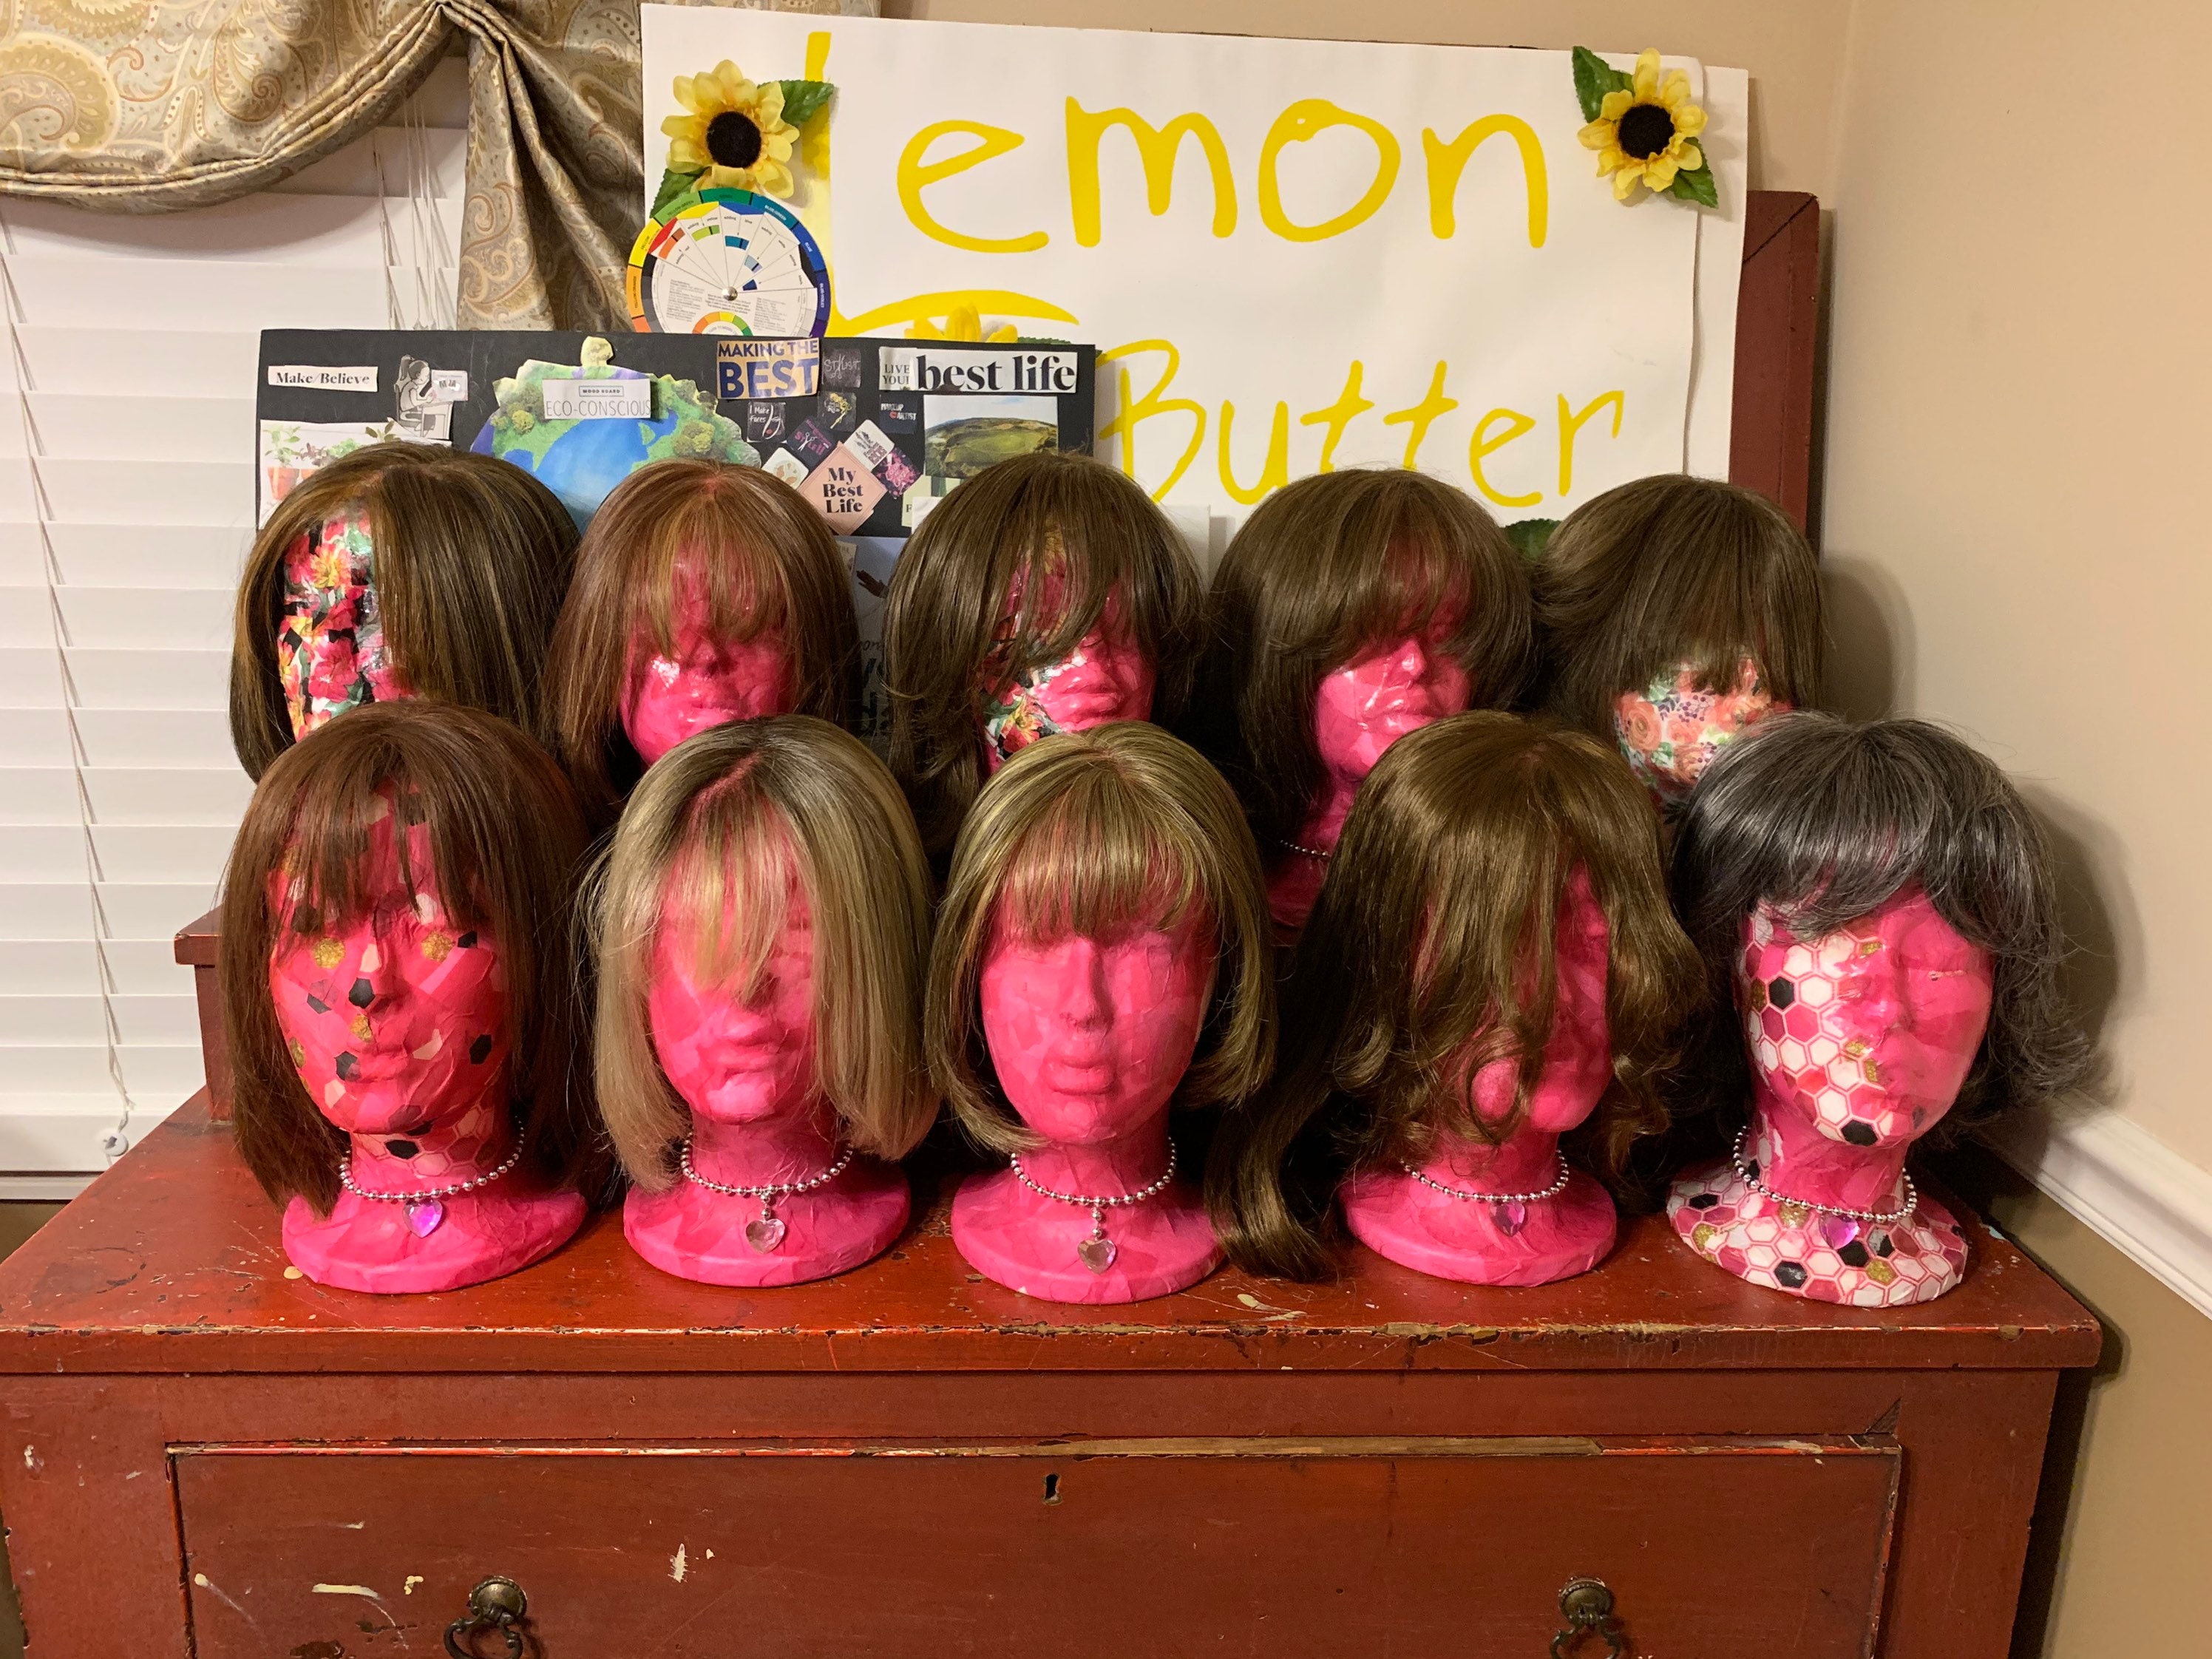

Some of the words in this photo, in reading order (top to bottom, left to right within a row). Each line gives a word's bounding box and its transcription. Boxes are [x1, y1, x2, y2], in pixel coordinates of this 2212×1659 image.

[719, 343, 784, 357] MAKING
[787, 340, 818, 355] THE
[884, 364, 910, 373] LIVE
[916, 355, 1003, 390] best
[1013, 355, 1076, 391] life
[276, 372, 370, 384] Make/Believe
[719, 358, 818, 398] BEST
[546, 400, 651, 417] ECO-CONSCIOUS
[1098, 339, 1624, 507] Butter
[828, 467, 856, 485] My
[823, 484, 864, 498] Best
[826, 498, 863, 513] Life
